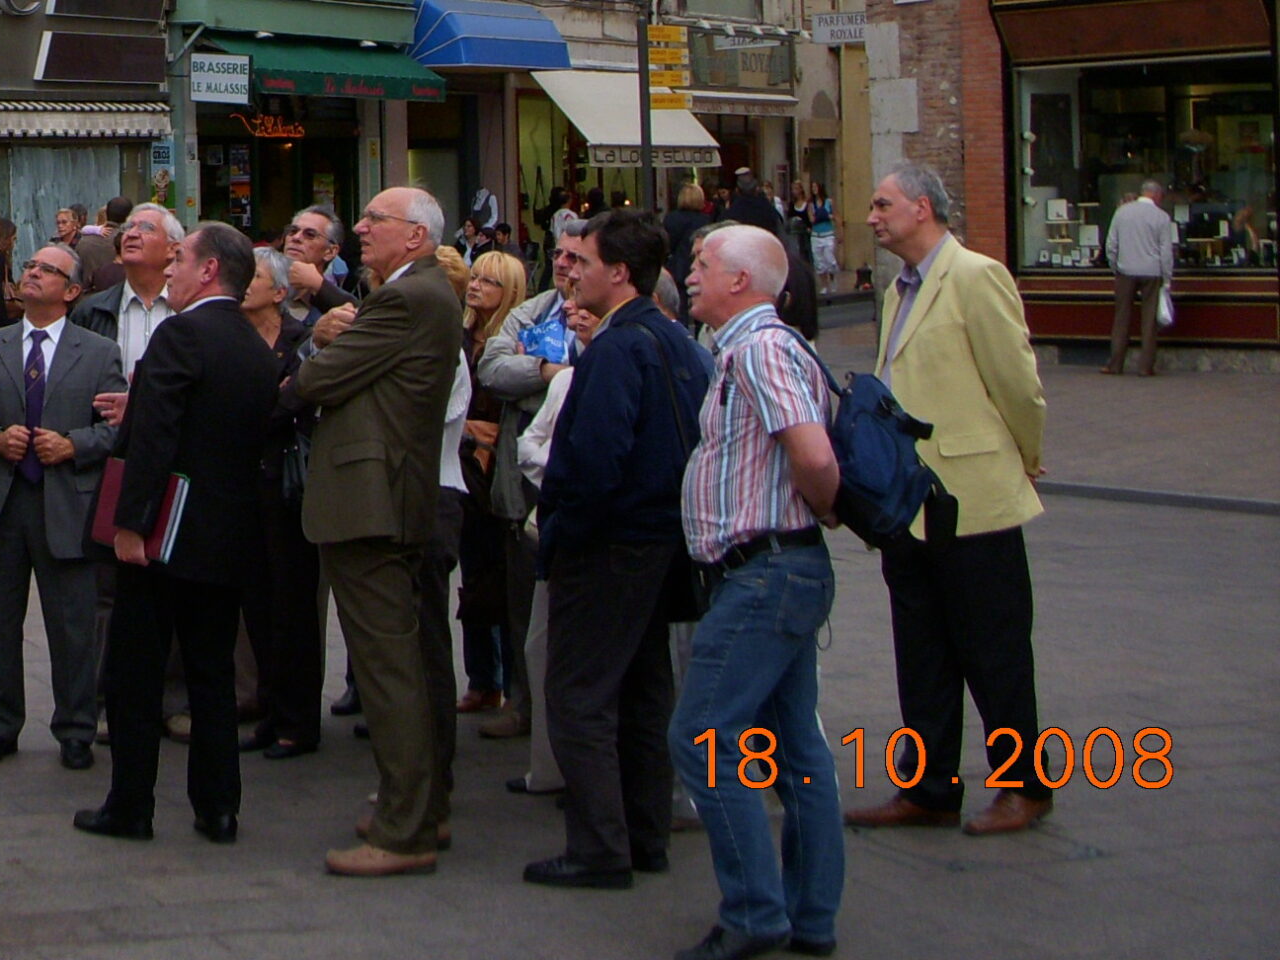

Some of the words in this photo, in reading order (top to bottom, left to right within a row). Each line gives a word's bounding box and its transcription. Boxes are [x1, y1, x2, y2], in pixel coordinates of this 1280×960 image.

[830, 28, 865, 40] ROYALE
[192, 60, 249, 75] BRASSERIE
[192, 81, 202, 93] LE
[205, 82, 249, 96] MALASSIS
